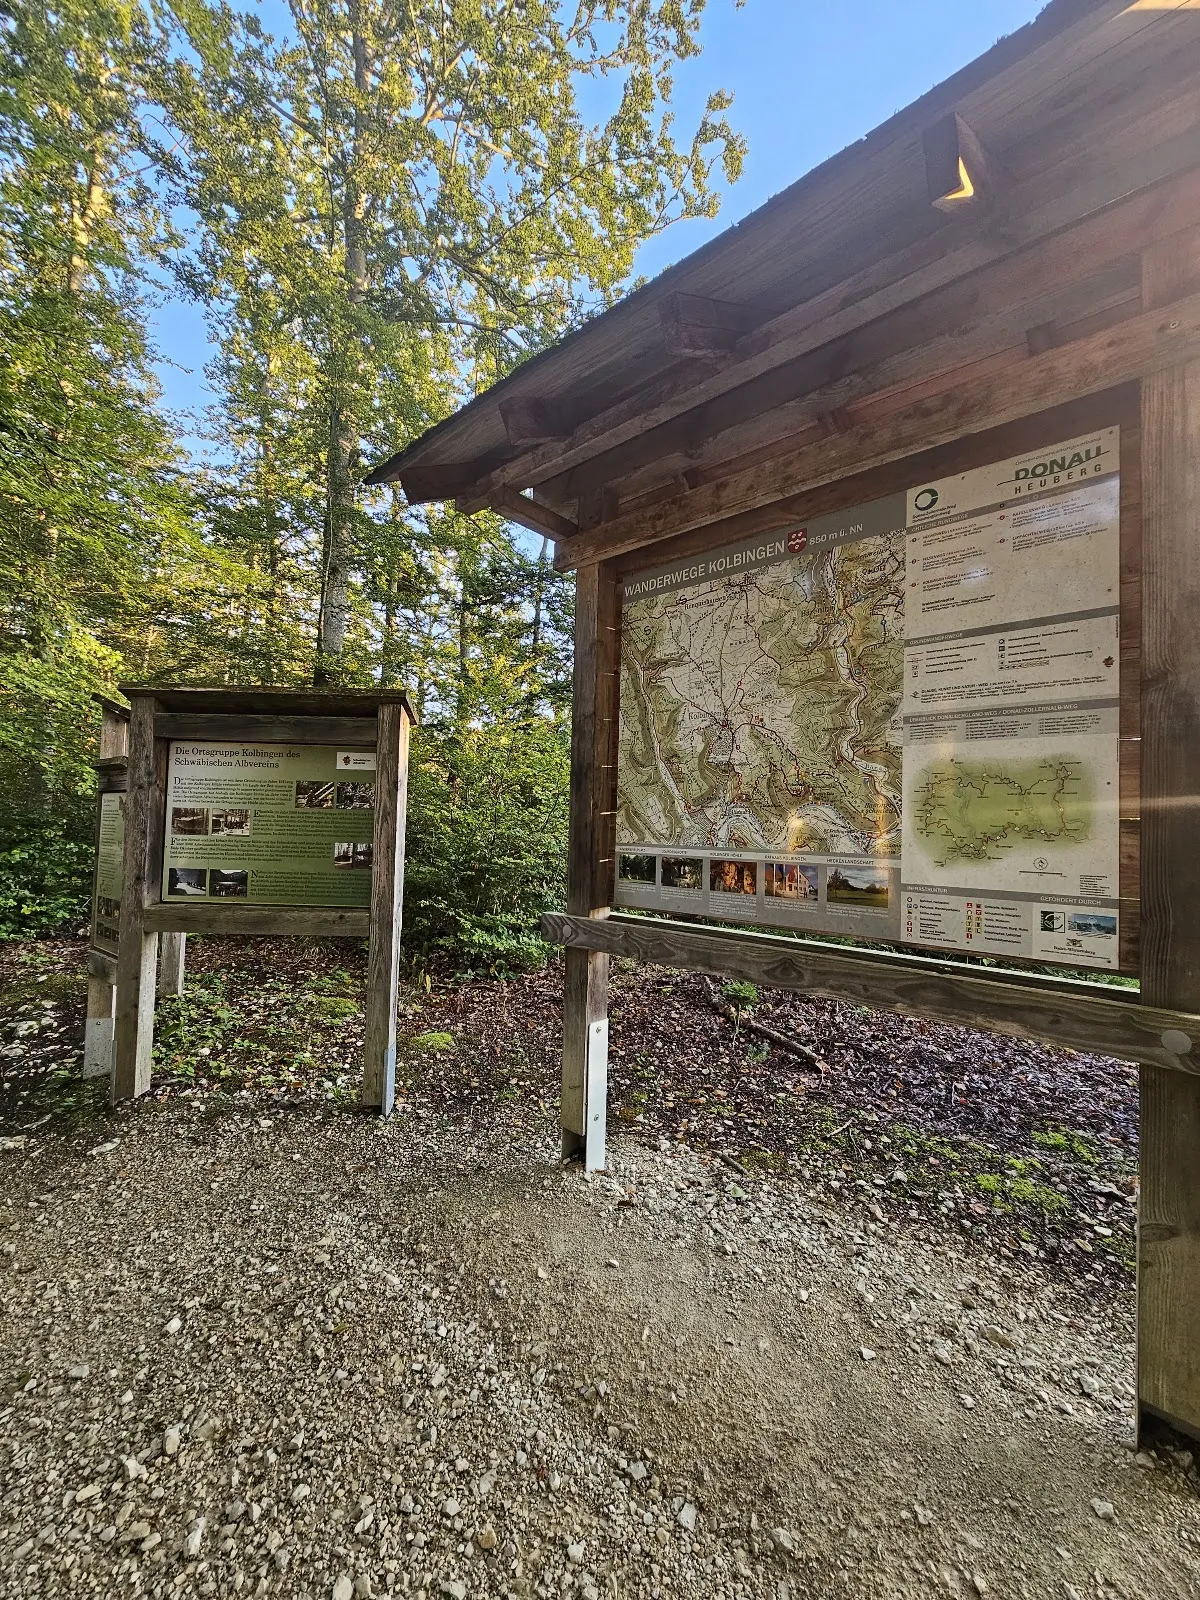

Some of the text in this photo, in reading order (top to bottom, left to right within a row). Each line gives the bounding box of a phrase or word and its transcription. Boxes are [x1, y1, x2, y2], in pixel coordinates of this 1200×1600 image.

[1014, 445, 1102, 481] DONAU
[1014, 464, 1102, 494] HEUBERG
[623, 523, 863, 597] WANDERWEGE KOLBINGEN 850 m ü. NN
[175, 747, 301, 759] Die Ortsgruppe Kolbingen des
[174, 758, 280, 768] Schwäbischen Albvereins
[907, 885, 948, 893] INFRASTRUKTUR
[1040, 895, 1101, 906] GEFÖRDERT DURCH
